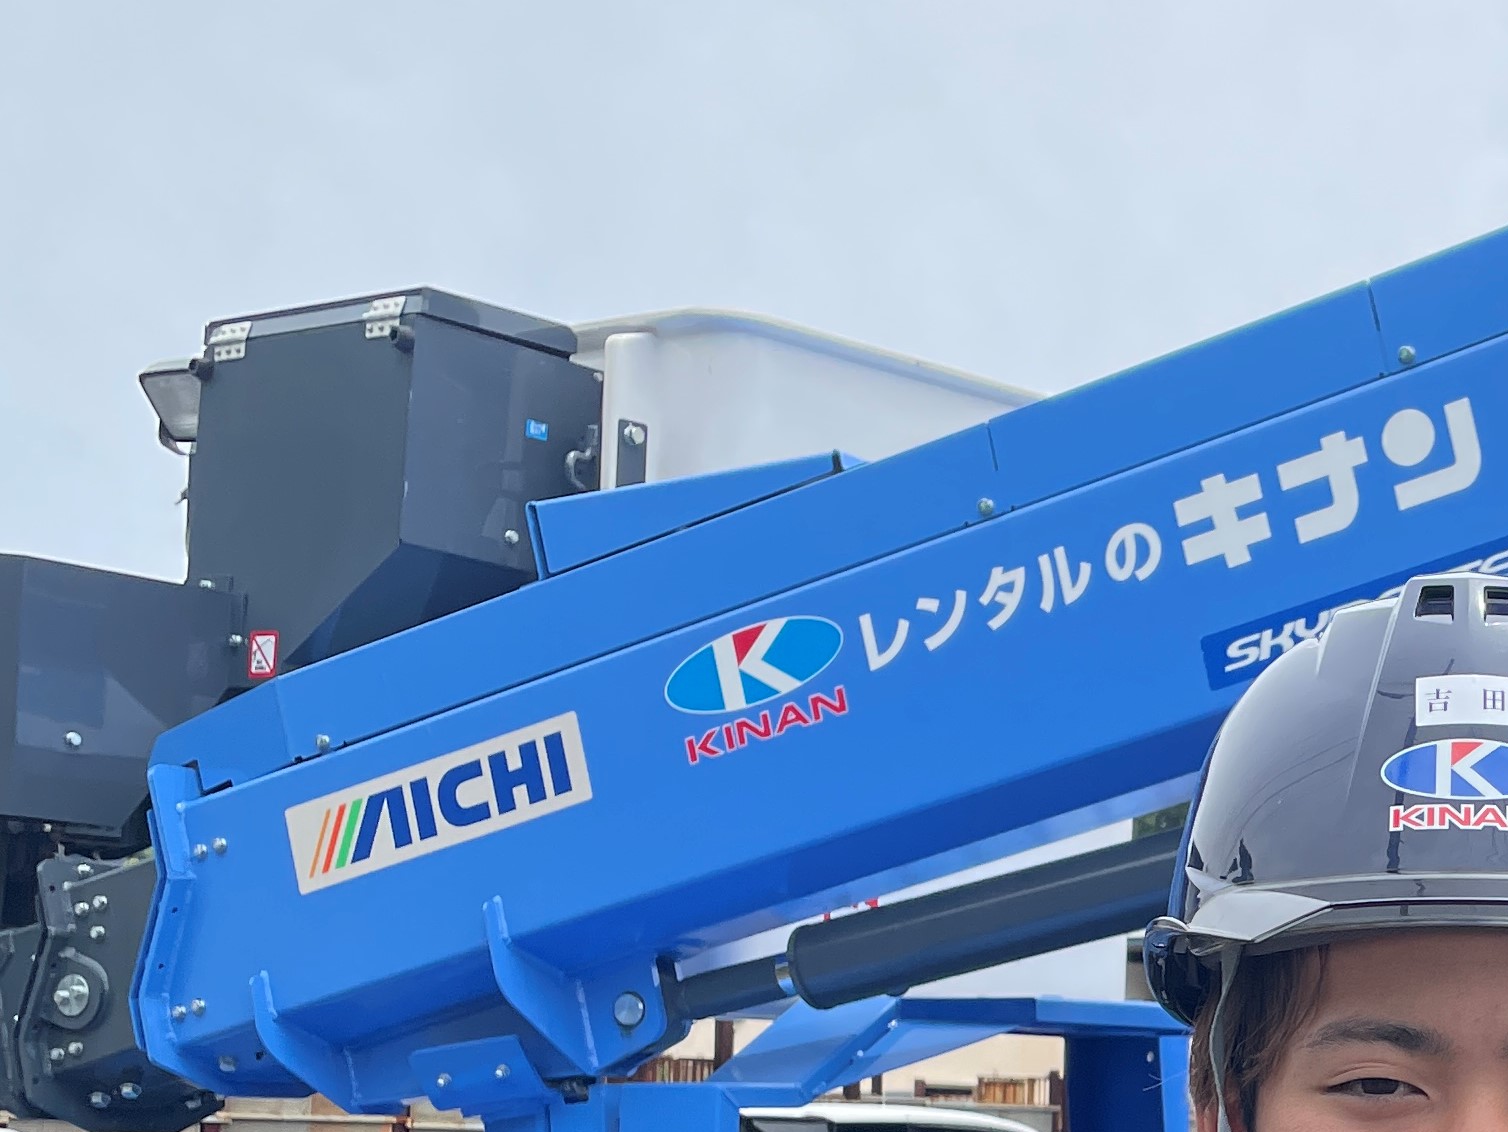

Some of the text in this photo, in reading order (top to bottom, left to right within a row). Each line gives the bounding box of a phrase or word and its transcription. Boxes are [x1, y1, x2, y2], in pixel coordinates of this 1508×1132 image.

[859, 397, 1482, 671] レンタルのキナン
[684, 685, 848, 765] KINAN
[351, 731, 572, 864] AICHI
